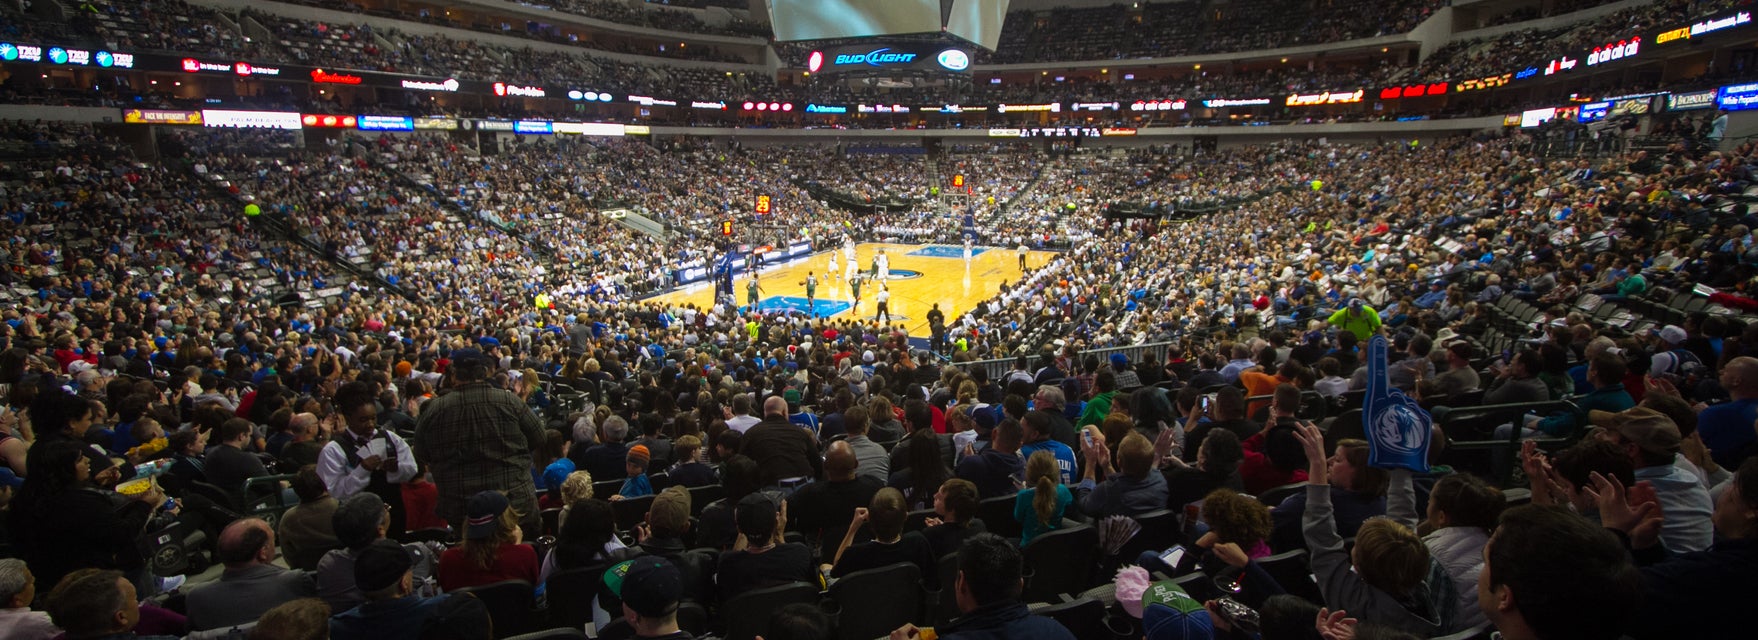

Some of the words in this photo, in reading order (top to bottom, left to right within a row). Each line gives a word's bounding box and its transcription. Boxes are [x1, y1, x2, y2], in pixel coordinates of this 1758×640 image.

[17, 46, 41, 55] TXU
[67, 49, 89, 59] TXU
[112, 53, 133, 62] TXU
[834, 54, 865, 65] BUD
[872, 53, 916, 62] LIGHT
